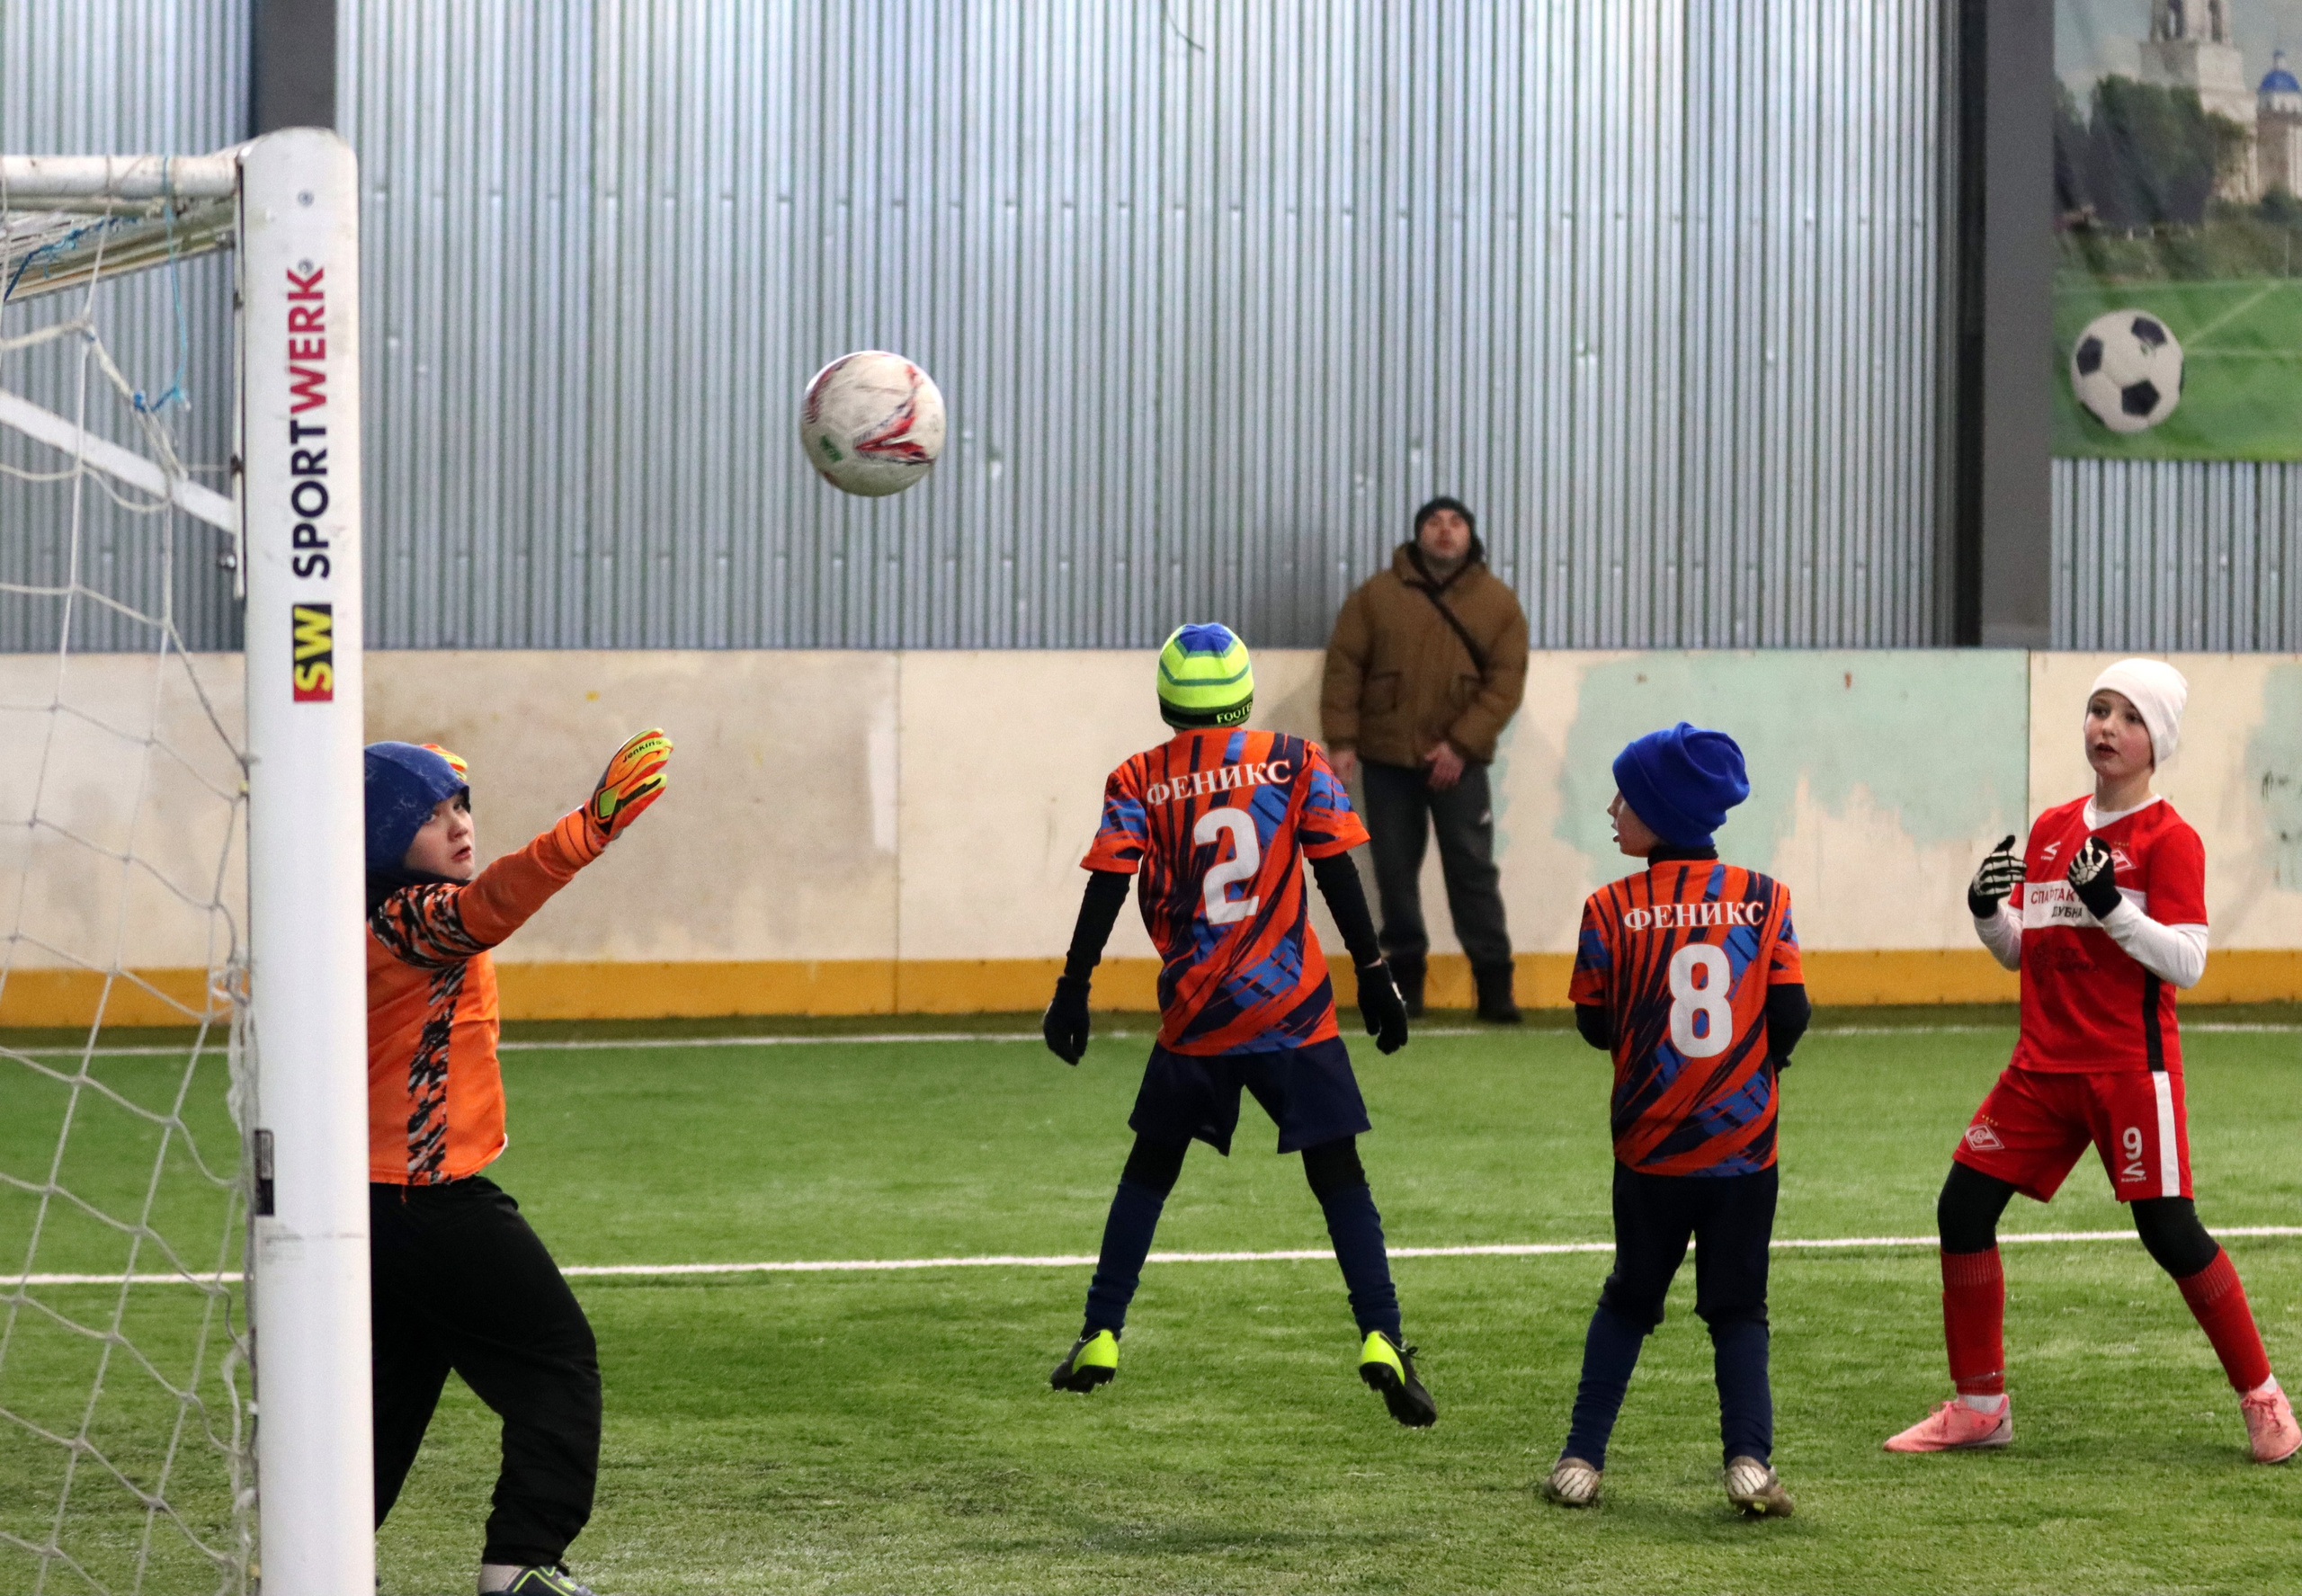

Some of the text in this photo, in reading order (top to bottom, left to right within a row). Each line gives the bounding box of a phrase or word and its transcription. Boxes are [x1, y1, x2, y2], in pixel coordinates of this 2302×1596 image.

[287, 267, 333, 692] SW SPORTWERK
[1147, 760, 1291, 805] ФЕНИКС
[1194, 807, 1260, 925] 2
[2030, 887, 2075, 905] СПАРТАК
[2052, 905, 2083, 918] ДУБНА
[1624, 901, 1765, 931] ФЕНИКС
[1669, 943, 1733, 1058] 8
[2122, 1127, 2143, 1160] 9
